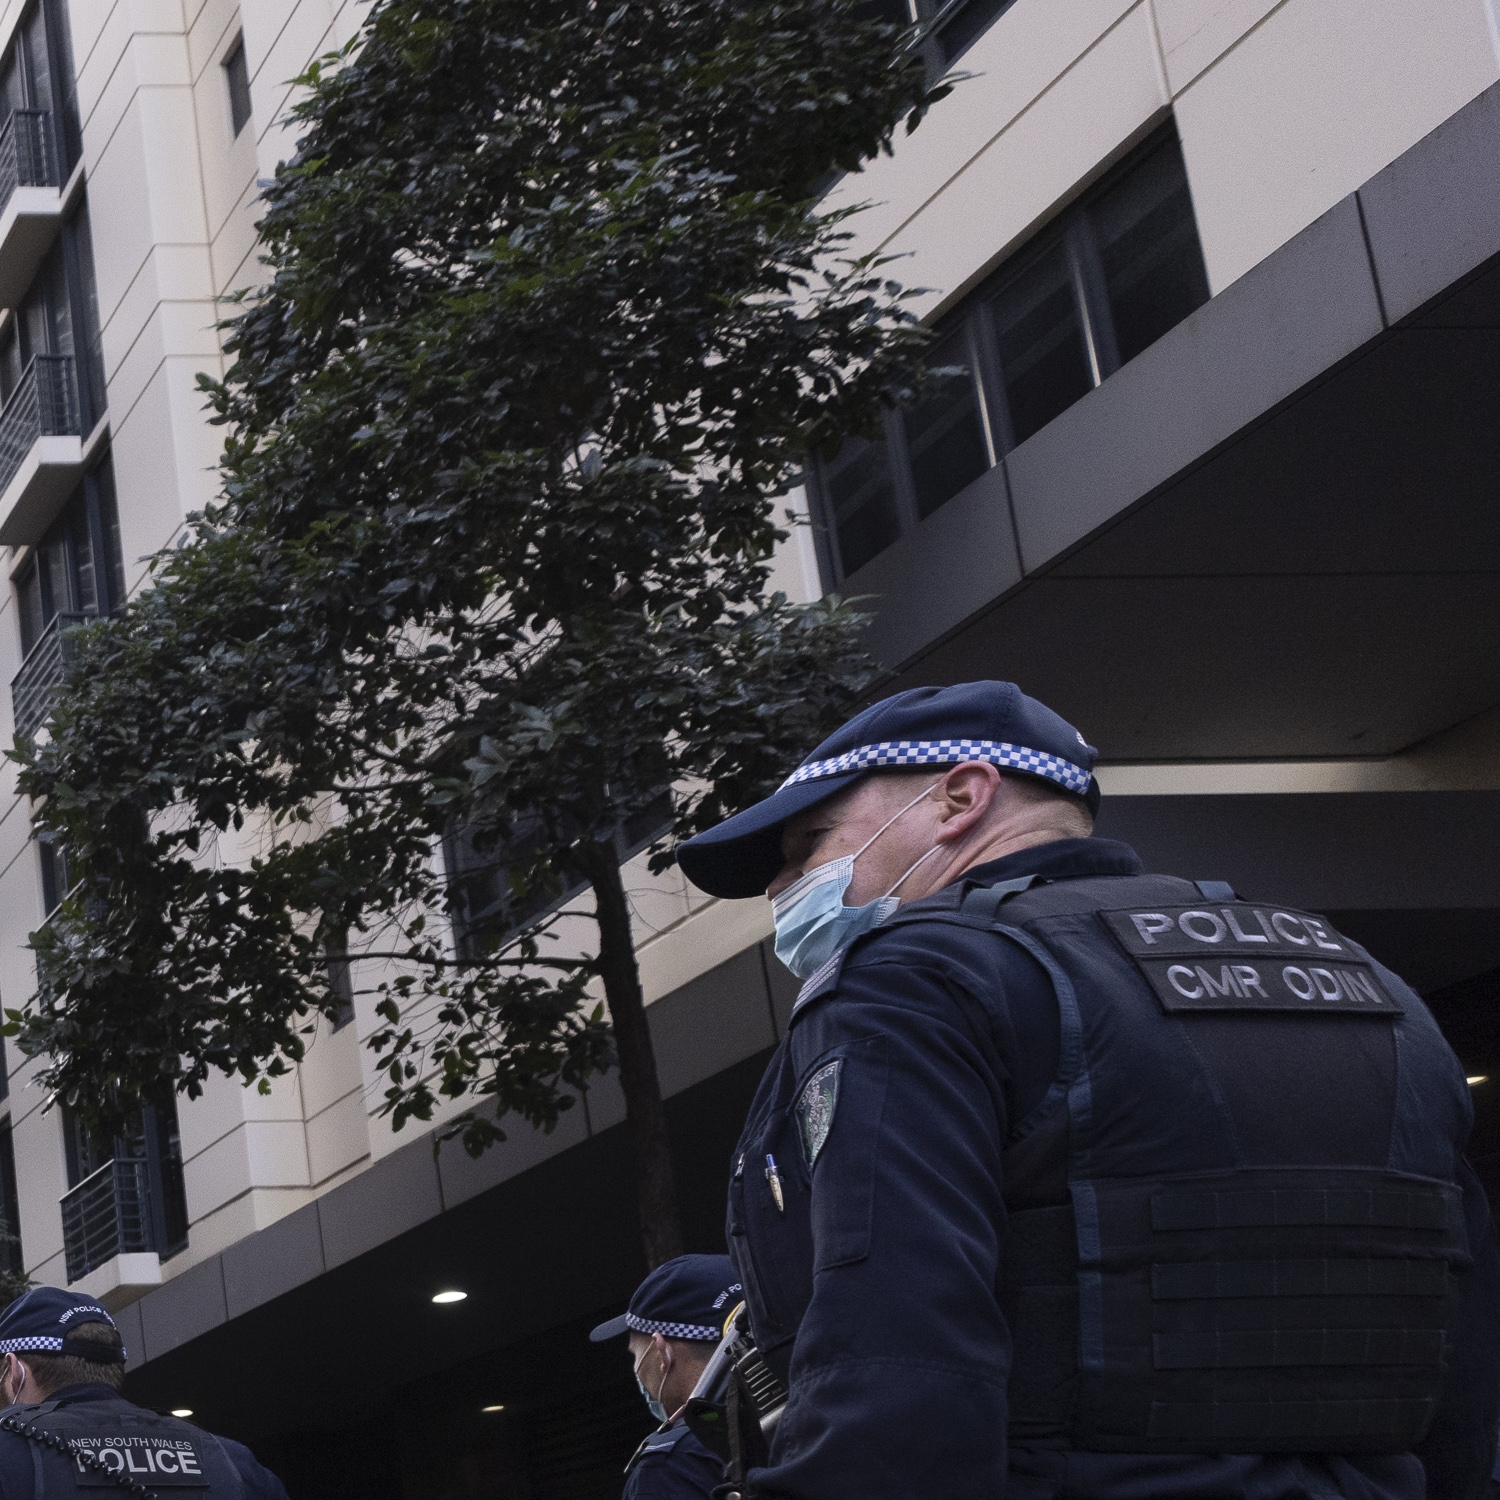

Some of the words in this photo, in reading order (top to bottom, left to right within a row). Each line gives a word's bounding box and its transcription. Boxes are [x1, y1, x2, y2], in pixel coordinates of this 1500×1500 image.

[1129, 908, 1342, 950] POLICE
[1167, 965, 1269, 1000] CMR
[1282, 966, 1384, 1004] ODIN
[712, 1290, 729, 1309] NSW
[59, 1309, 74, 1324] NSW
[73, 1305, 102, 1314] POLICE
[71, 1438, 101, 1448] NEW
[104, 1437, 149, 1447] SOUTH
[151, 1438, 193, 1450] WALES
[76, 1448, 202, 1475] POLICE
